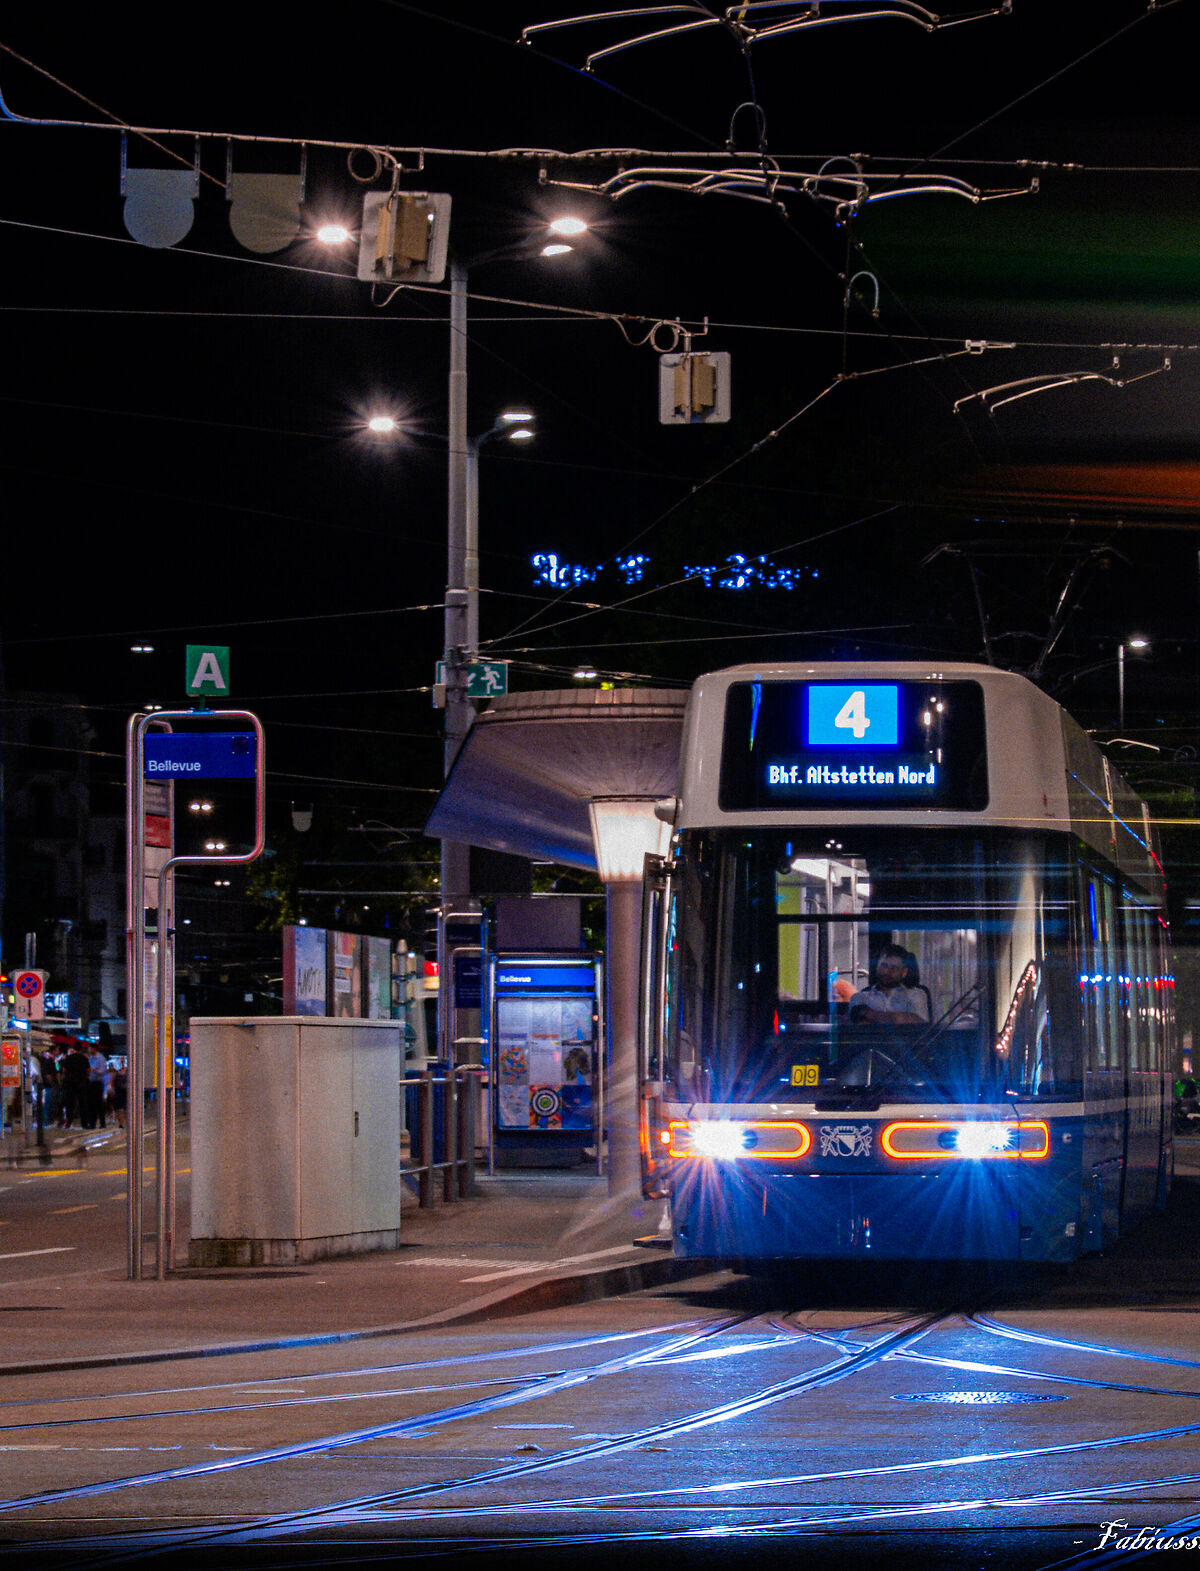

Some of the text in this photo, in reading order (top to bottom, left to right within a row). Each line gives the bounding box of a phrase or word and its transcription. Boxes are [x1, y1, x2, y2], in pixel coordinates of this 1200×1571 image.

[191, 652, 226, 688] A
[835, 691, 870, 738] 4
[148, 760, 202, 772] Bellevue
[770, 765, 935, 784] Bhf. Altstetten Nord
